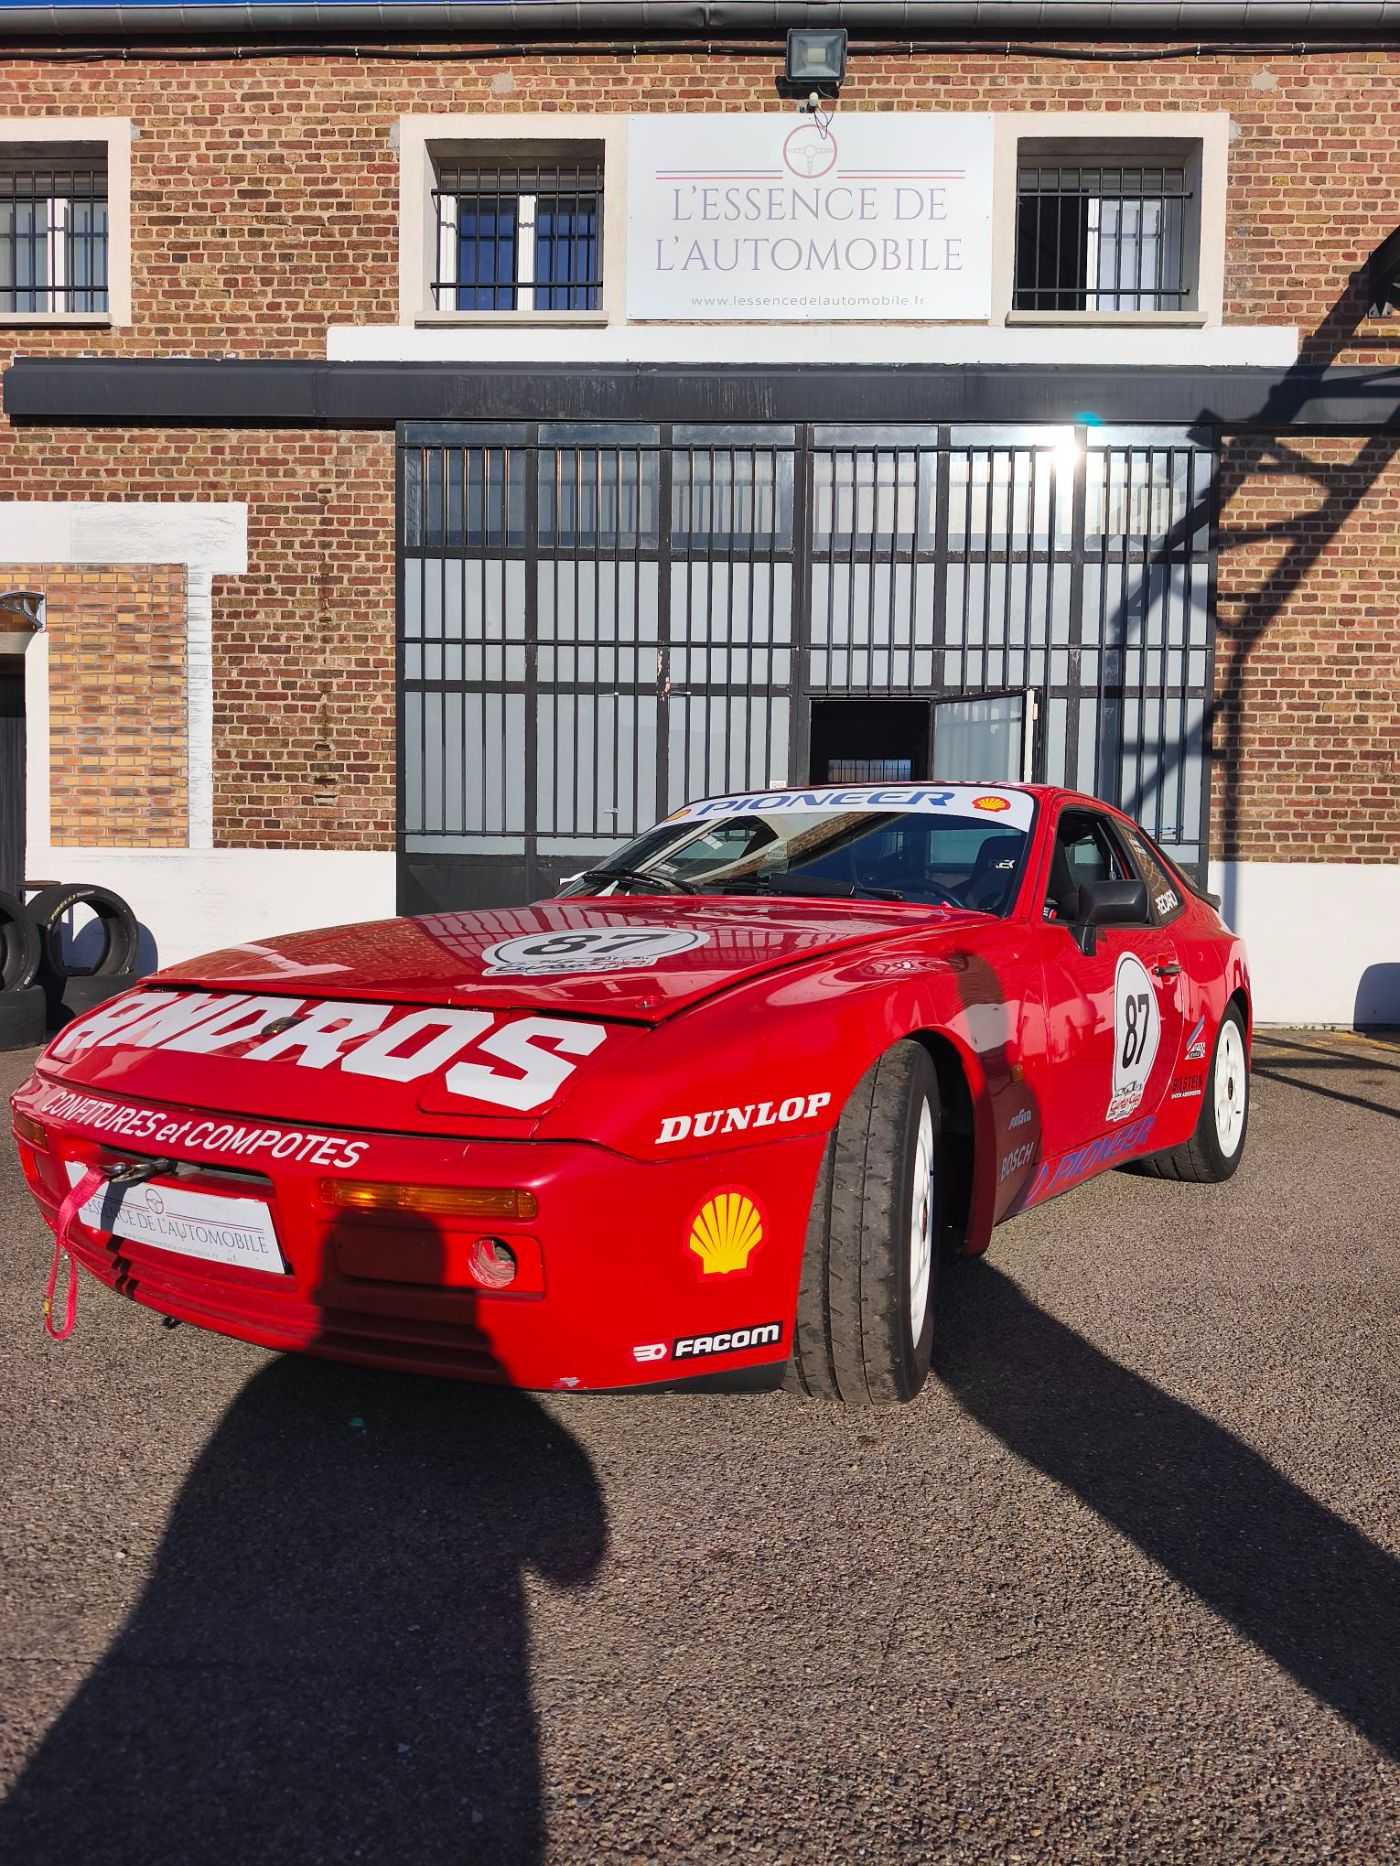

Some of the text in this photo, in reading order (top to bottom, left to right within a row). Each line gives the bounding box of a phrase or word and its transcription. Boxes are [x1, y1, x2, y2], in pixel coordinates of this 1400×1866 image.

[672, 186, 948, 222] L'ESSENCE DE
[655, 236, 964, 272] L'AUTOMOBILE
[690, 294, 925, 308] www.lessencedelautomobile.fr
[696, 790, 958, 816] PIONEER
[522, 933, 673, 955] 87
[1121, 993, 1150, 1070] 87
[53, 991, 607, 1112] ANDROS
[40, 1091, 370, 1168] CONFITURES et COMPOTES
[655, 1091, 832, 1145] DUNLOP
[1001, 1141, 1035, 1182] BOSCH
[138, 1211, 157, 1232] DE
[157, 1213, 270, 1254] L'AUTOMOBILE
[674, 1324, 780, 1358] FACOM
